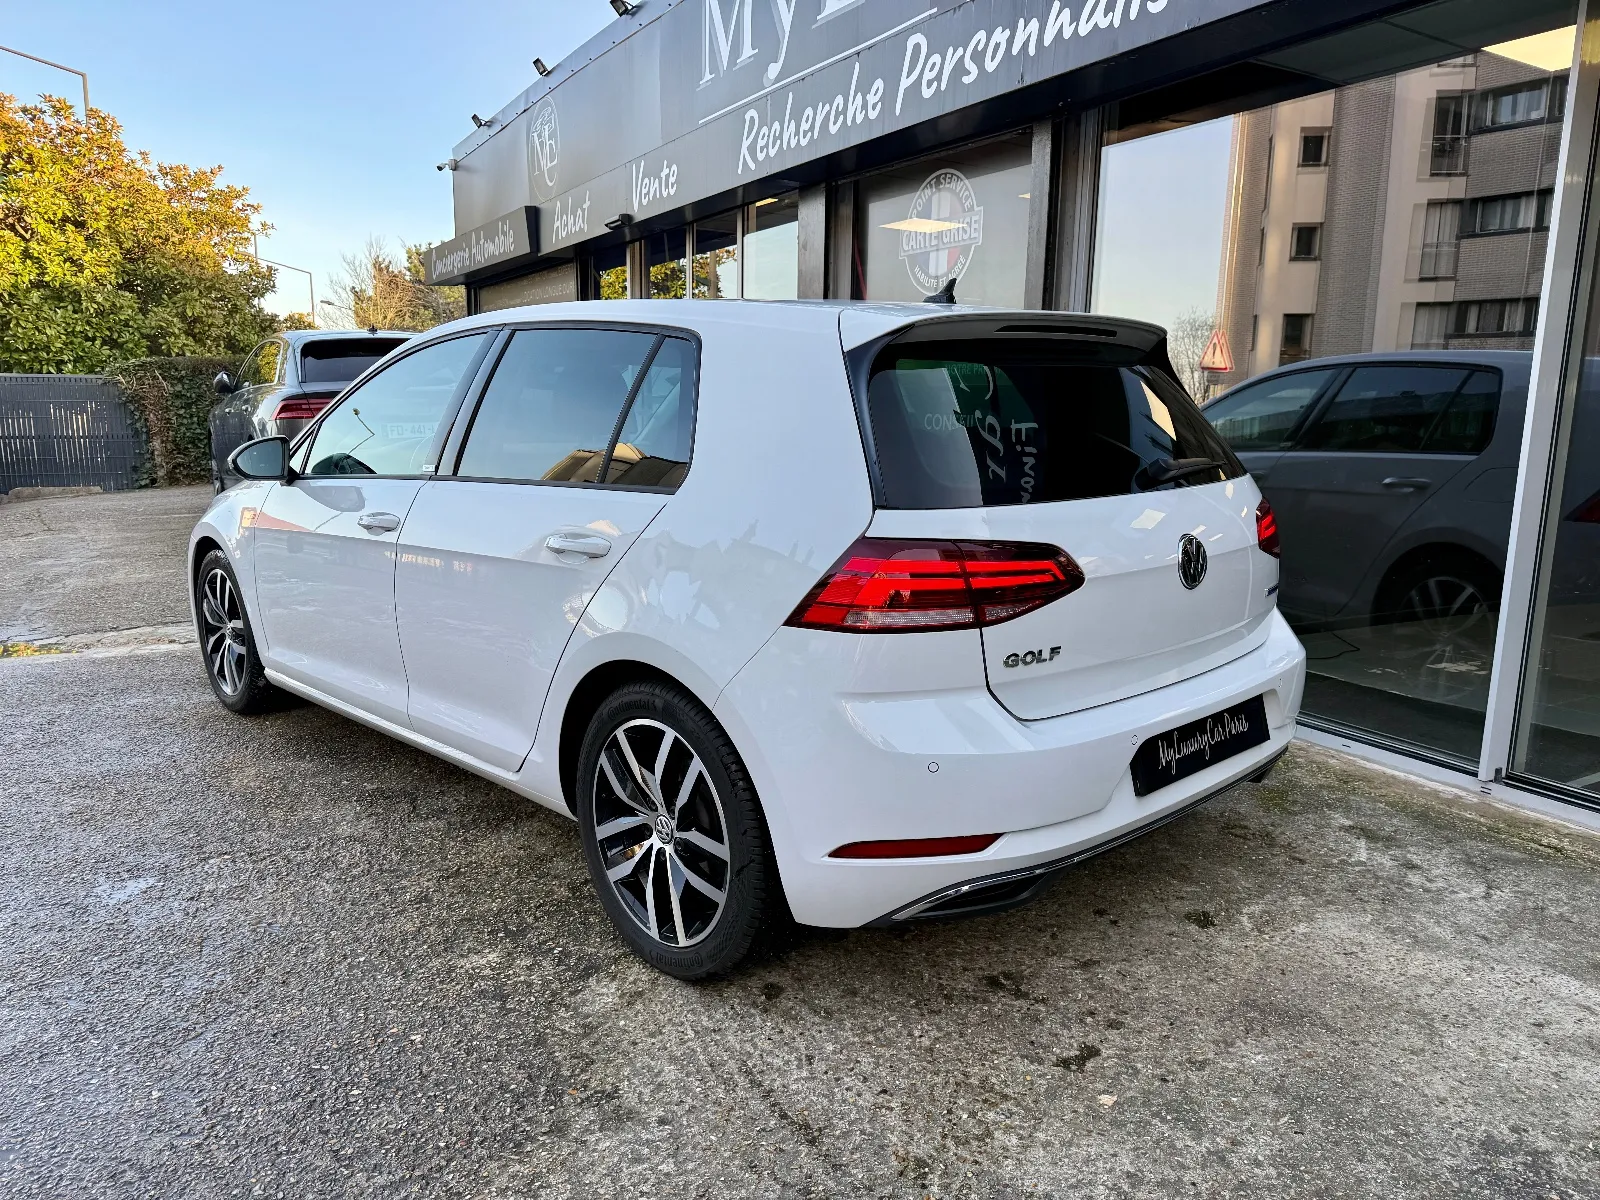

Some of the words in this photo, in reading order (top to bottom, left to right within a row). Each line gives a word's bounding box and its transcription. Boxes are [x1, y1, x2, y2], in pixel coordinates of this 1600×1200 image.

[737, 62, 885, 175] Recherche
[895, 0, 1168, 117] Personna
[632, 160, 678, 213] Vente
[911, 177, 937, 219] POINT
[939, 173, 973, 212] SERVICE
[552, 190, 591, 244] Achat
[902, 227, 939, 251] CARTE
[942, 214, 980, 244] GRISE
[431, 242, 470, 280] Conciergerie
[471, 219, 515, 267] Automobile
[914, 264, 938, 288] HABILITÉ
[939, 277, 947, 287] ET
[1003, 645, 1062, 668] GOLF
[607, 698, 651, 721] Continental
